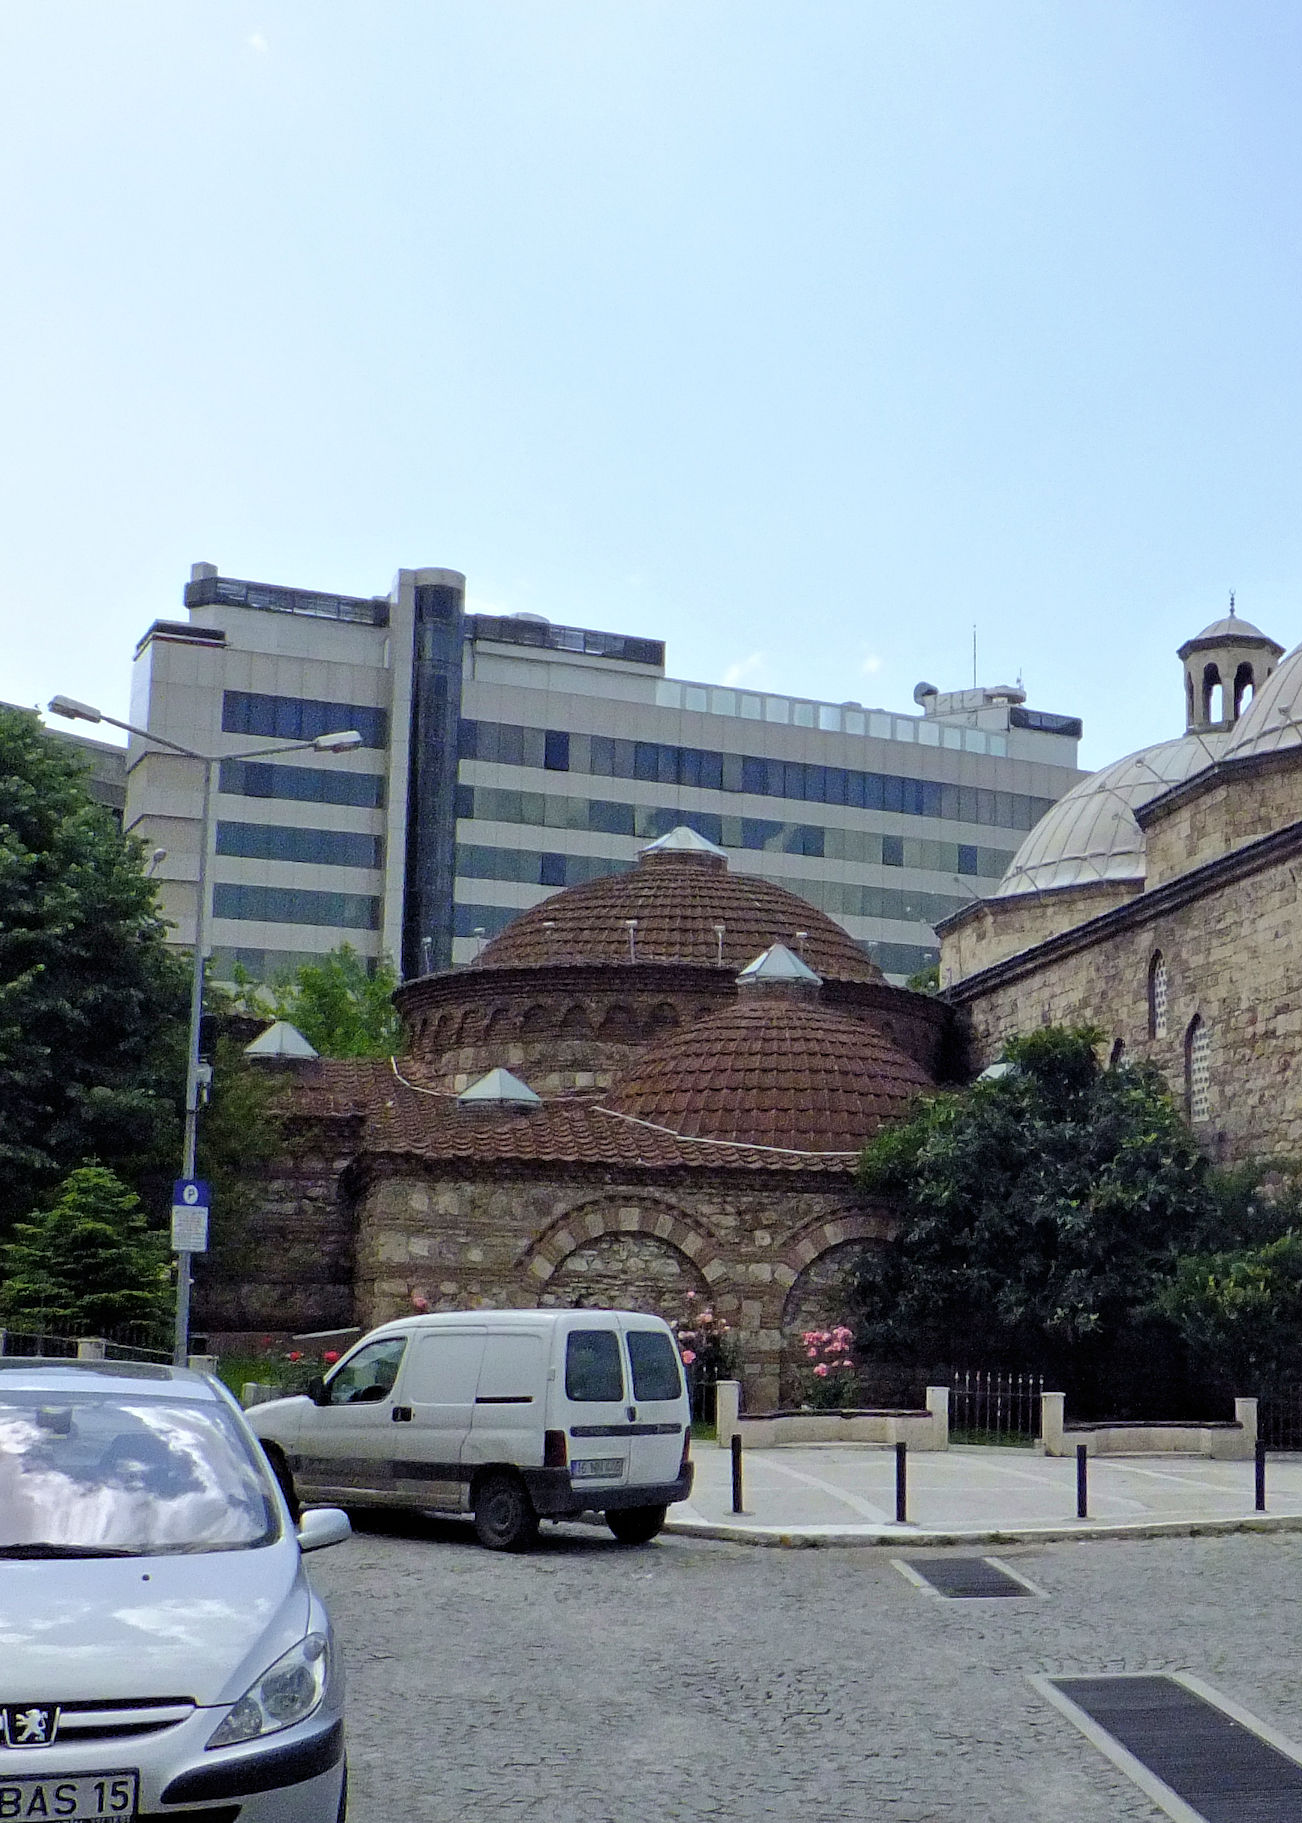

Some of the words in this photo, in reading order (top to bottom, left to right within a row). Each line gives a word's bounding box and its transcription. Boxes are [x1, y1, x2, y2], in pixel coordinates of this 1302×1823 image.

[188, 1188, 196, 1200] P
[0, 1783, 77, 1818] BAS
[93, 1780, 129, 1813] 15
